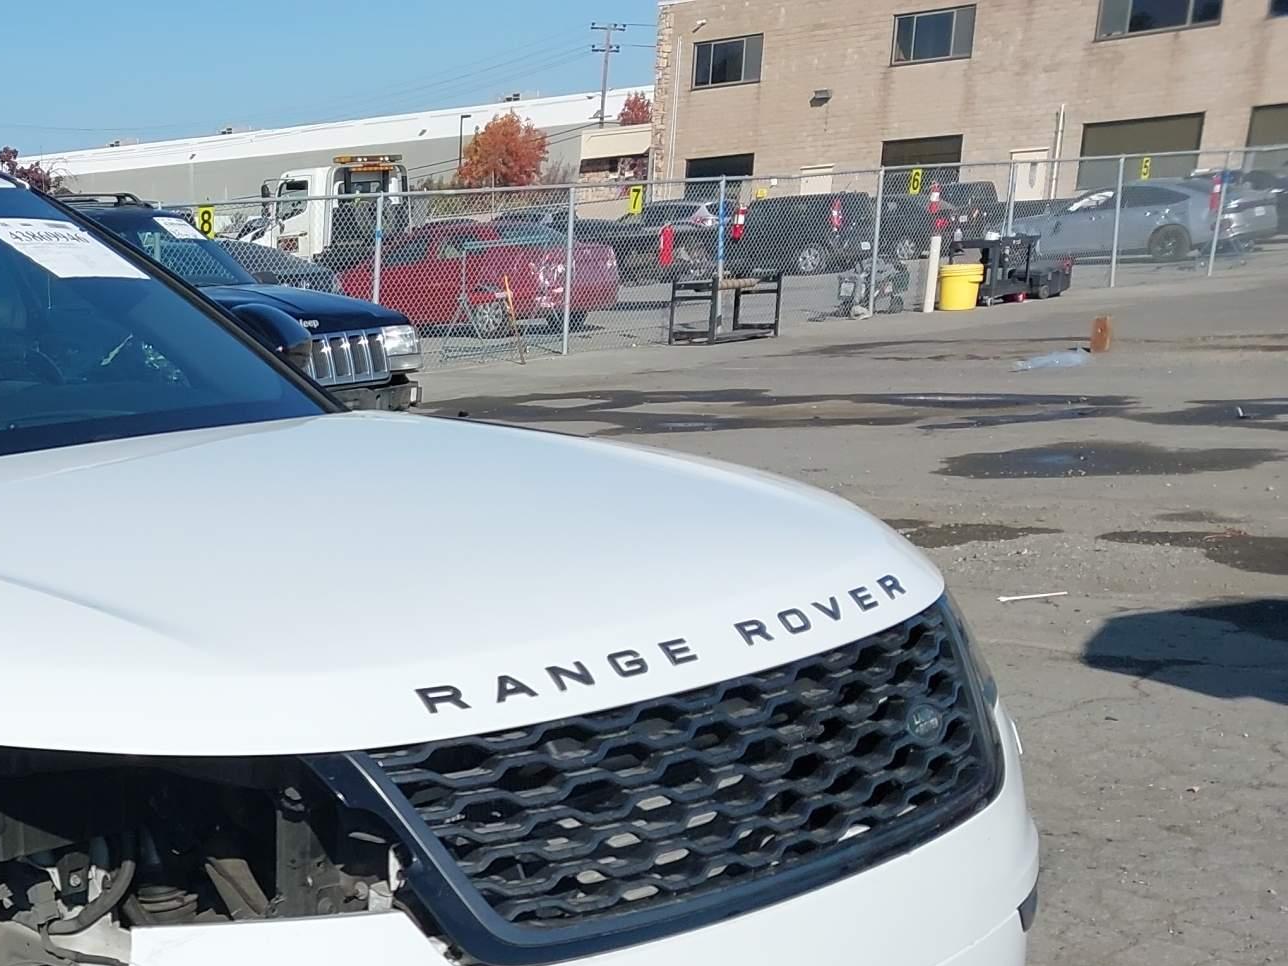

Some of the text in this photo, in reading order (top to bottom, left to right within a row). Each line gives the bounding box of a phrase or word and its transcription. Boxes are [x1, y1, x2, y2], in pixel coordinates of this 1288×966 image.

[1143, 159, 1150, 176] 5
[912, 171, 920, 191] 6
[632, 188, 641, 209] 7
[201, 210, 212, 235] 8
[8, 230, 91, 244] 43869946
[415, 574, 907, 714] RANGE ROVER
